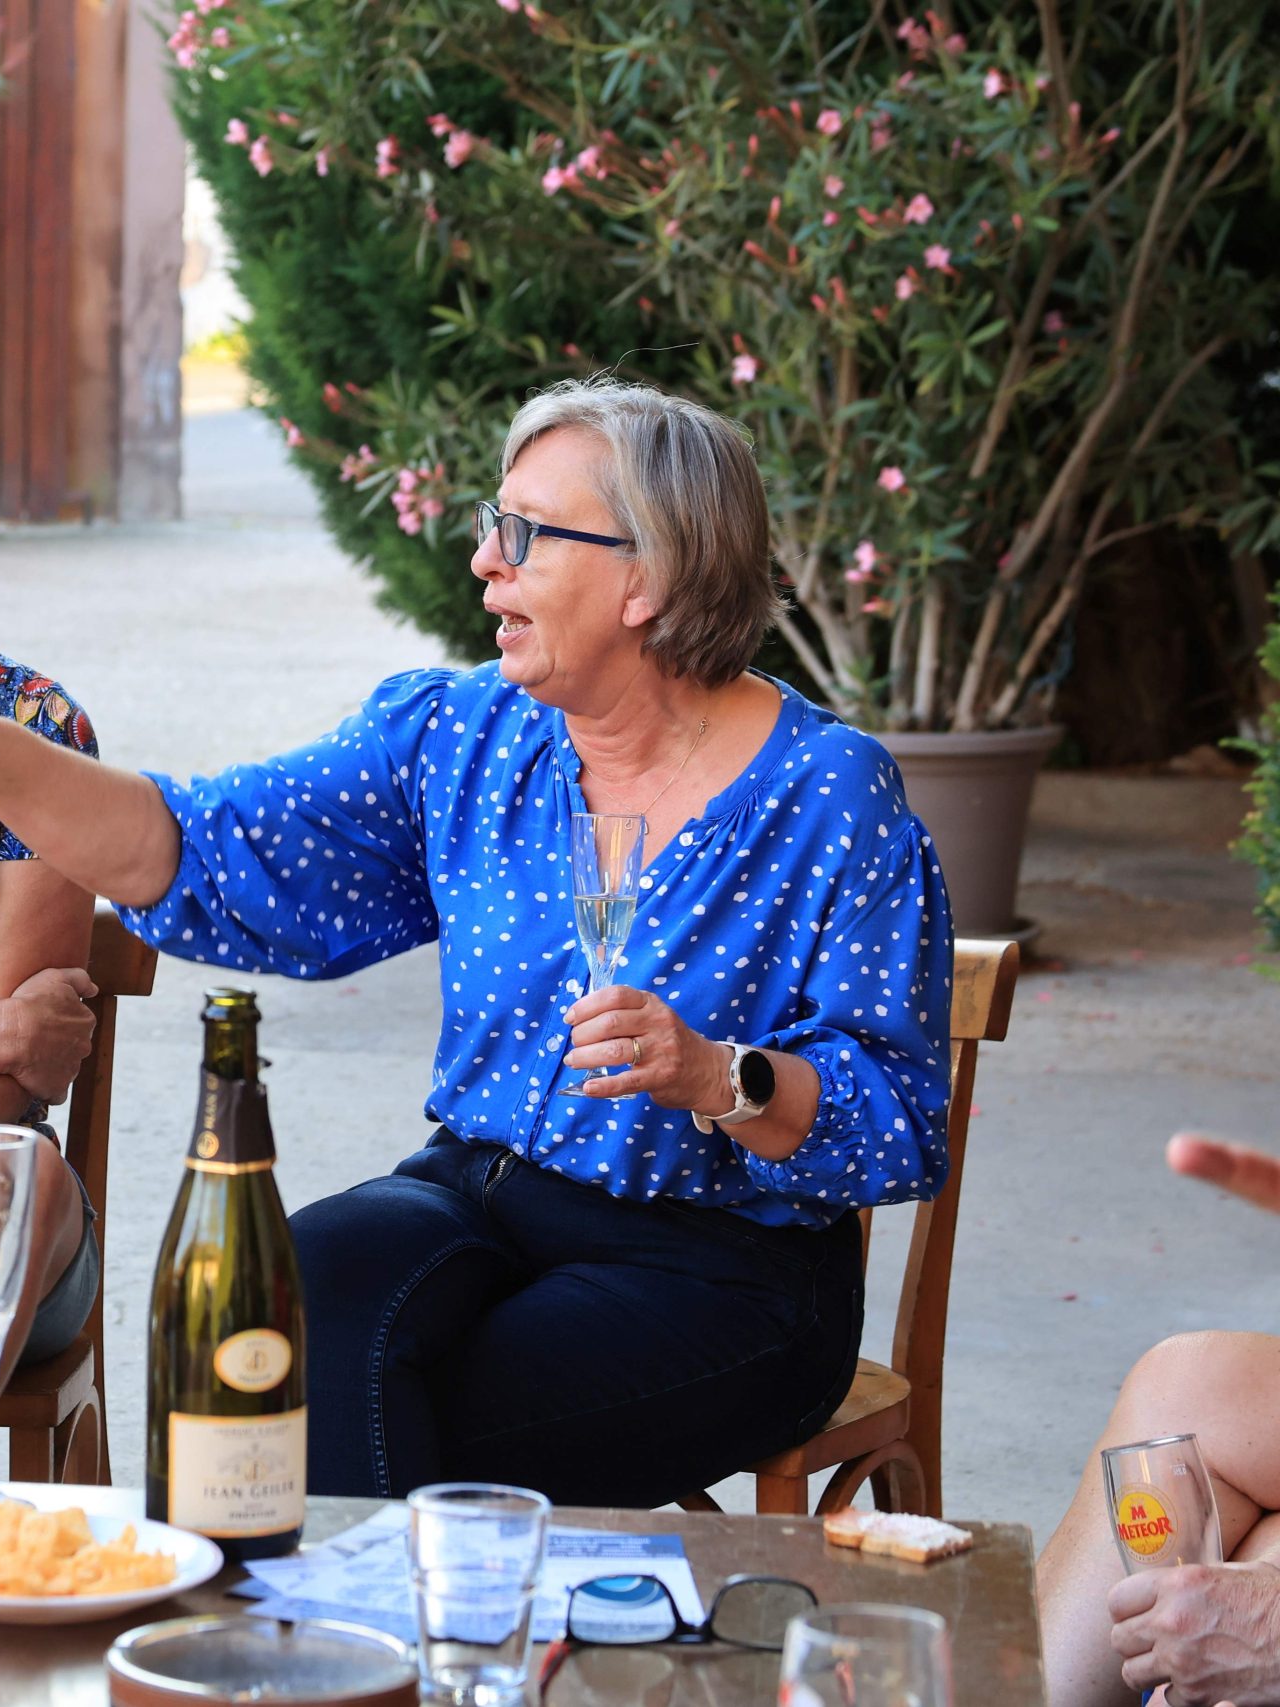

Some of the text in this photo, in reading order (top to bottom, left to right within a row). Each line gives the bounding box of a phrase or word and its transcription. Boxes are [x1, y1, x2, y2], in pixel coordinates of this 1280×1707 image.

[203, 1486, 242, 1499] JEAN
[1130, 1505, 1147, 1520] M
[1117, 1517, 1173, 1541] METEOR
